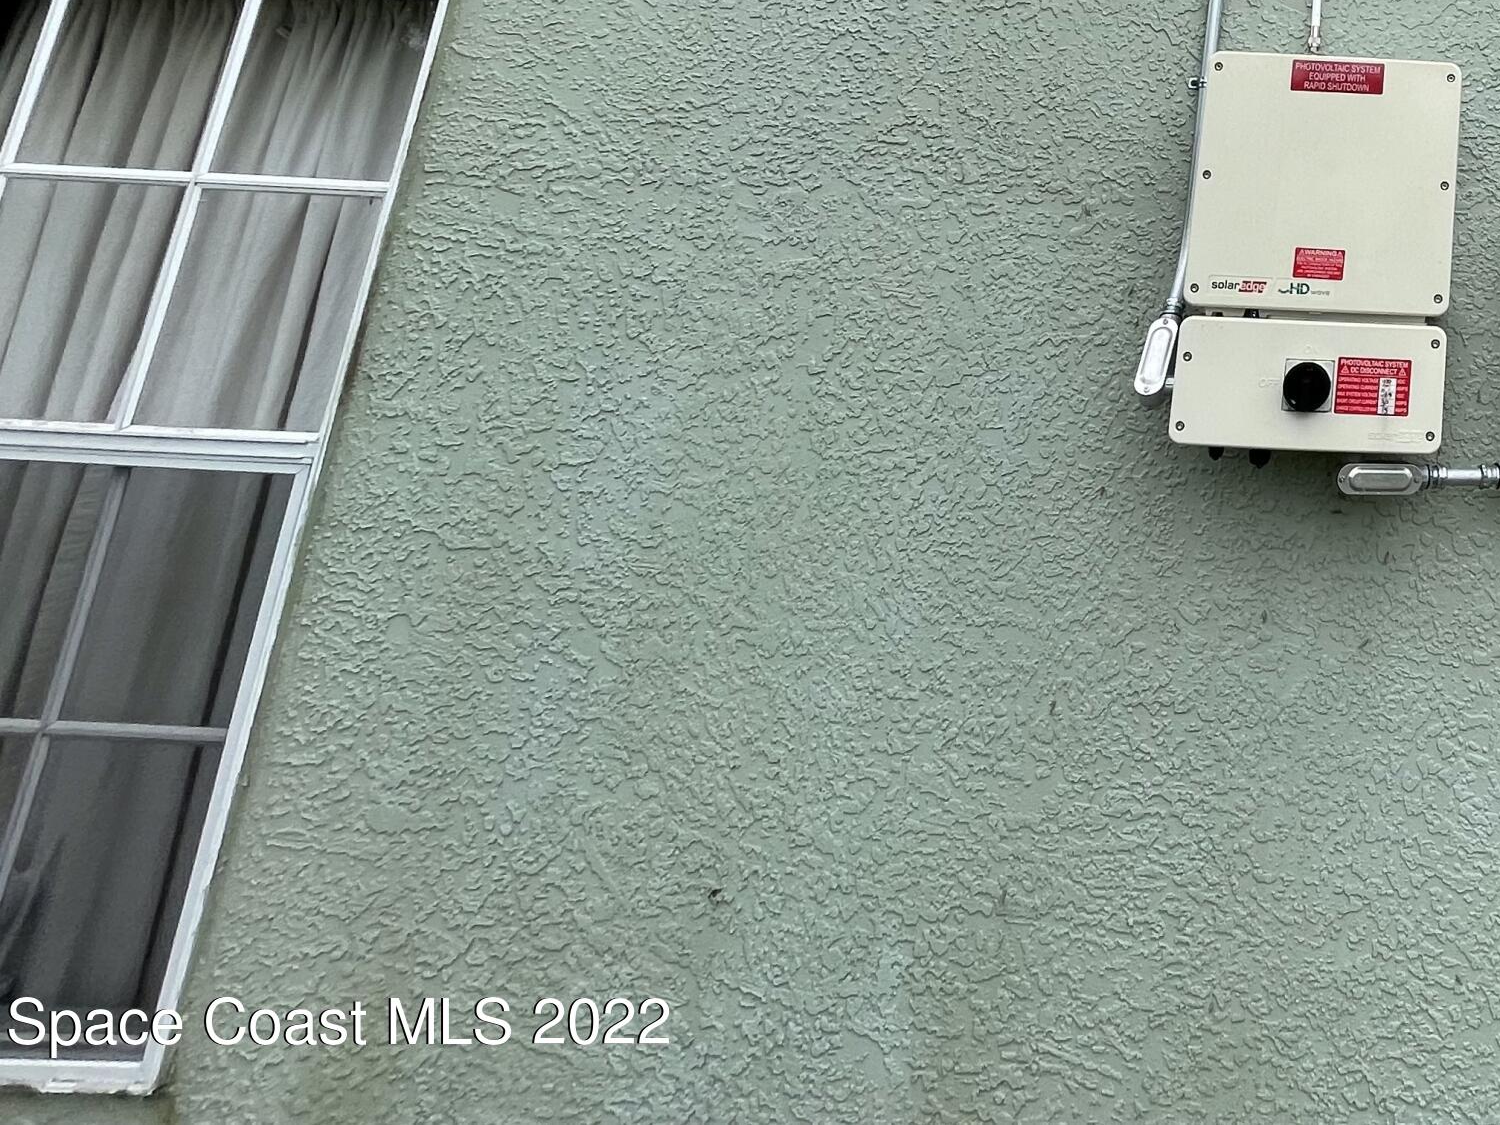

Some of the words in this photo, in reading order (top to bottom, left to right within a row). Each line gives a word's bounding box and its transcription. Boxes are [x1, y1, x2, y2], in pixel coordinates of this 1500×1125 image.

[1296, 62, 1350, 72] PHOTOVOLTAIC
[1351, 64, 1380, 74] SYSTEM
[1309, 72, 1346, 81] EQUIPPED
[1347, 74, 1366, 82] WITH
[1304, 81, 1326, 90] RAPID
[1327, 82, 1369, 92] SHUTDOWN
[1290, 282, 1310, 294] HD
[1341, 359, 1384, 367] PHOTOVOLTAIC
